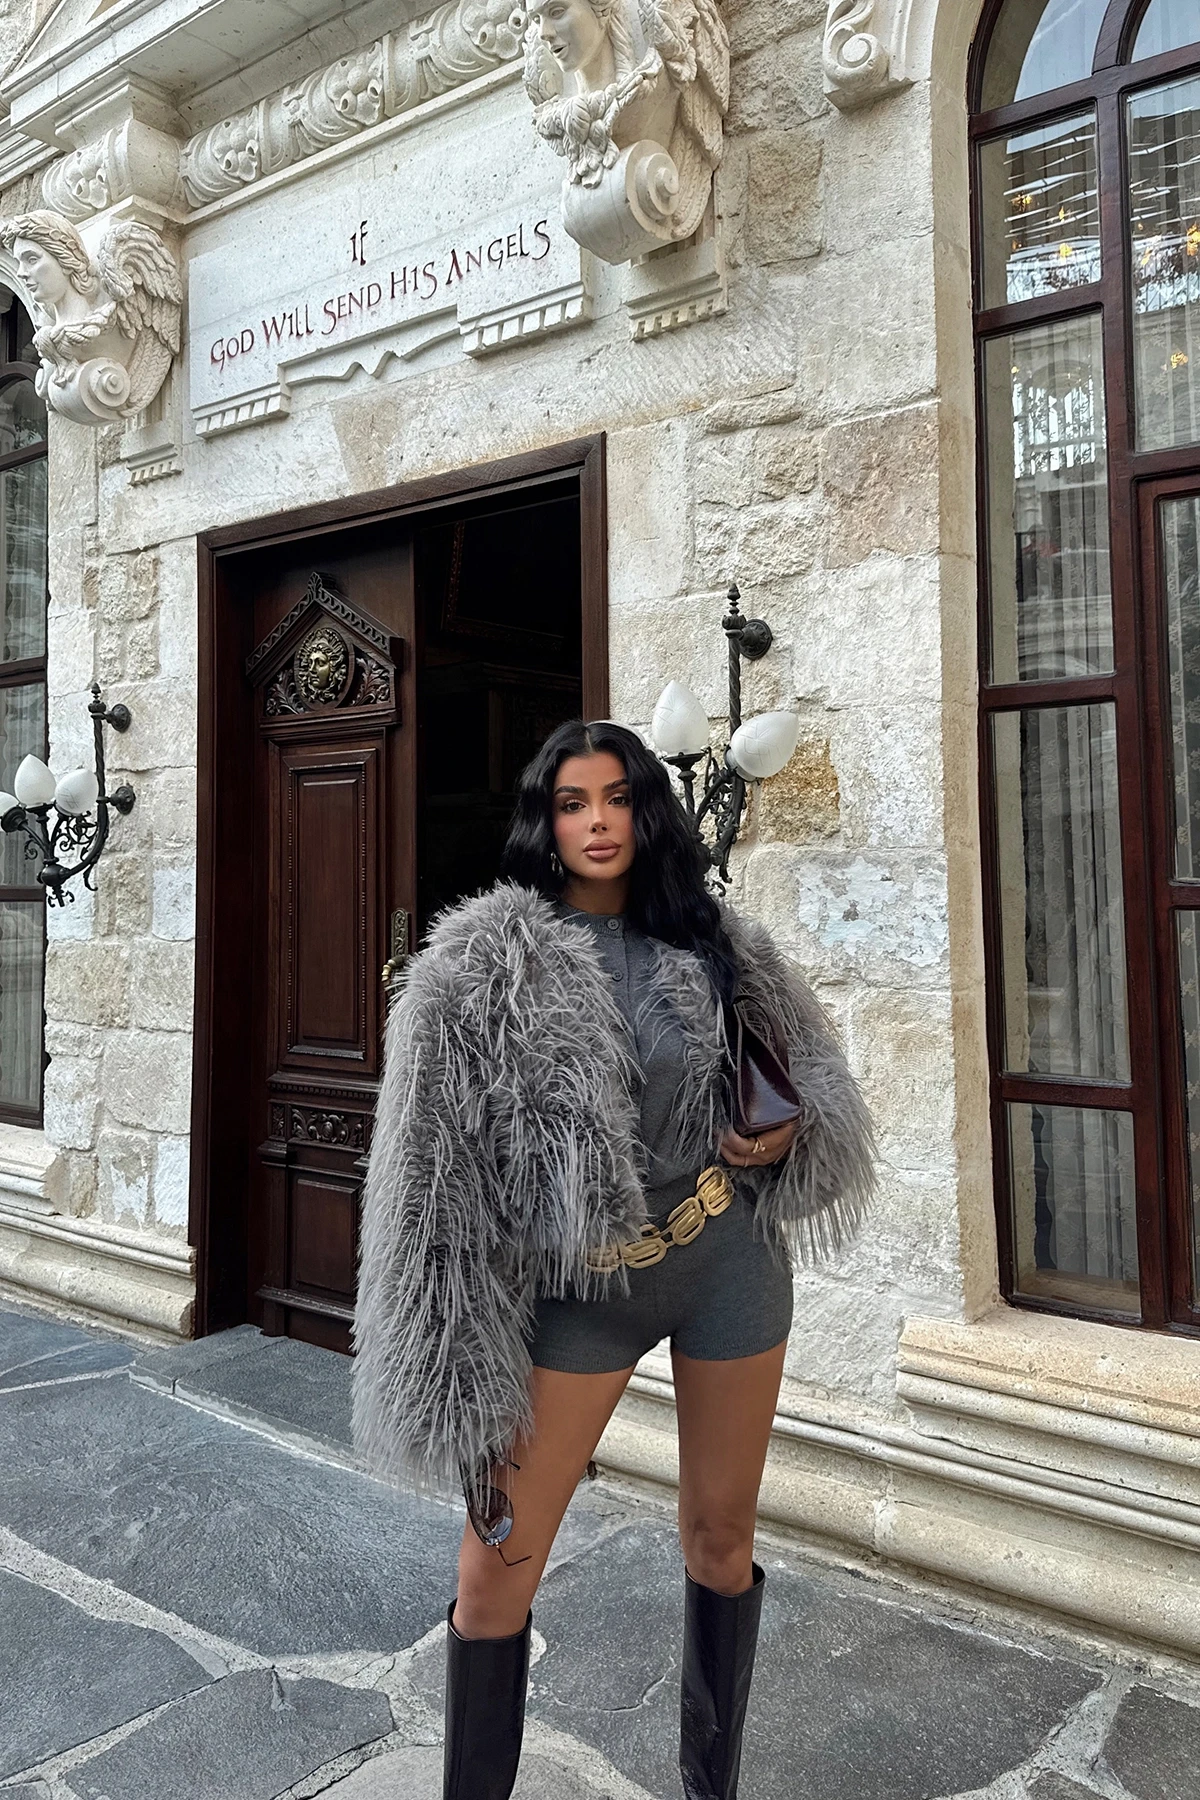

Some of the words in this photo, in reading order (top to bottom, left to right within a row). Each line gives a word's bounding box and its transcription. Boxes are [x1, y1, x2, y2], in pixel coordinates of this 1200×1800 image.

[210, 328, 255, 373] GOD
[321, 282, 382, 336] SEND
[390, 261, 438, 300] HIS
[445, 219, 551, 286] ANGELS
